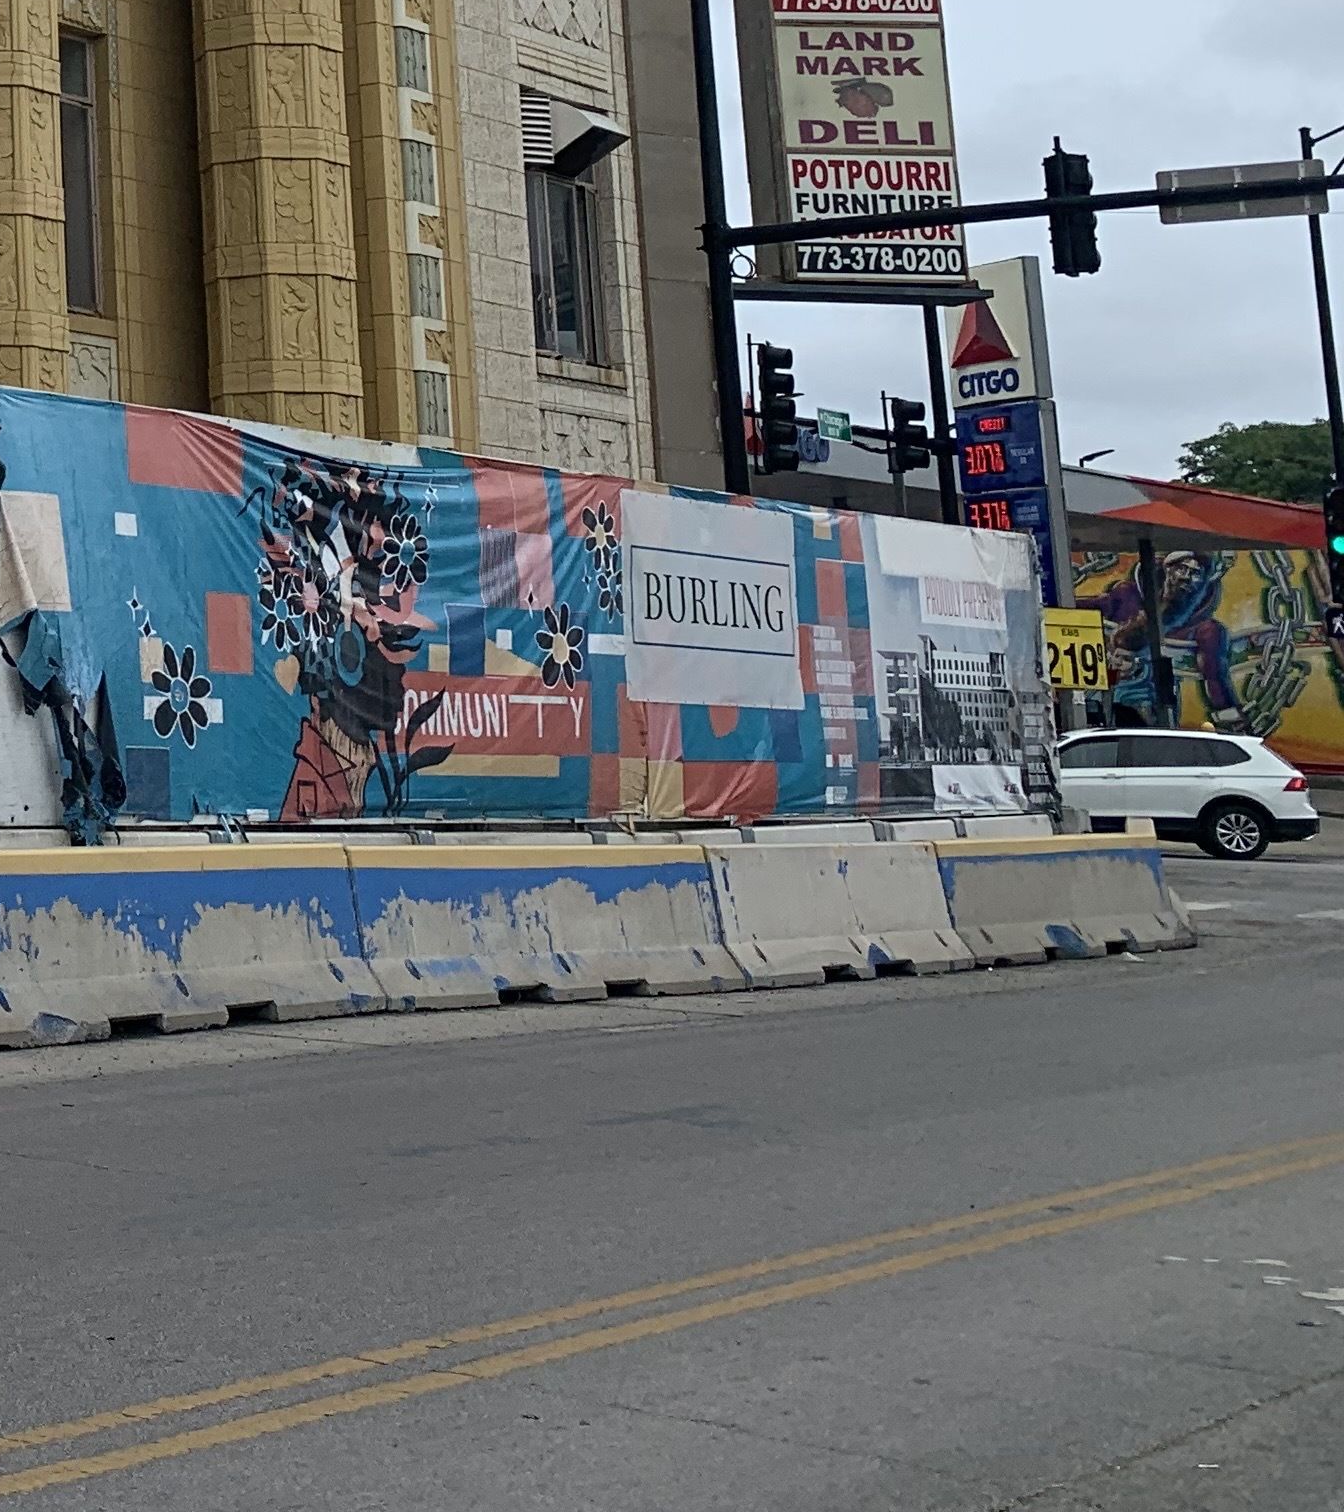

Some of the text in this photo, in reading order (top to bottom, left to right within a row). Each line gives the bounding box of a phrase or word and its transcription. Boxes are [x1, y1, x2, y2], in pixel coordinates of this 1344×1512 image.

[798, 31, 915, 51] LAND
[795, 56, 925, 76] MARK
[798, 119, 936, 146] DELI
[791, 158, 952, 192] POTPOURRI
[796, 192, 953, 215] FURNITURE
[797, 245, 962, 273] 773-378-0200
[958, 367, 1020, 399] CITGO
[643, 571, 784, 633] BURLING
[394, 688, 584, 738] OMMUNITY
